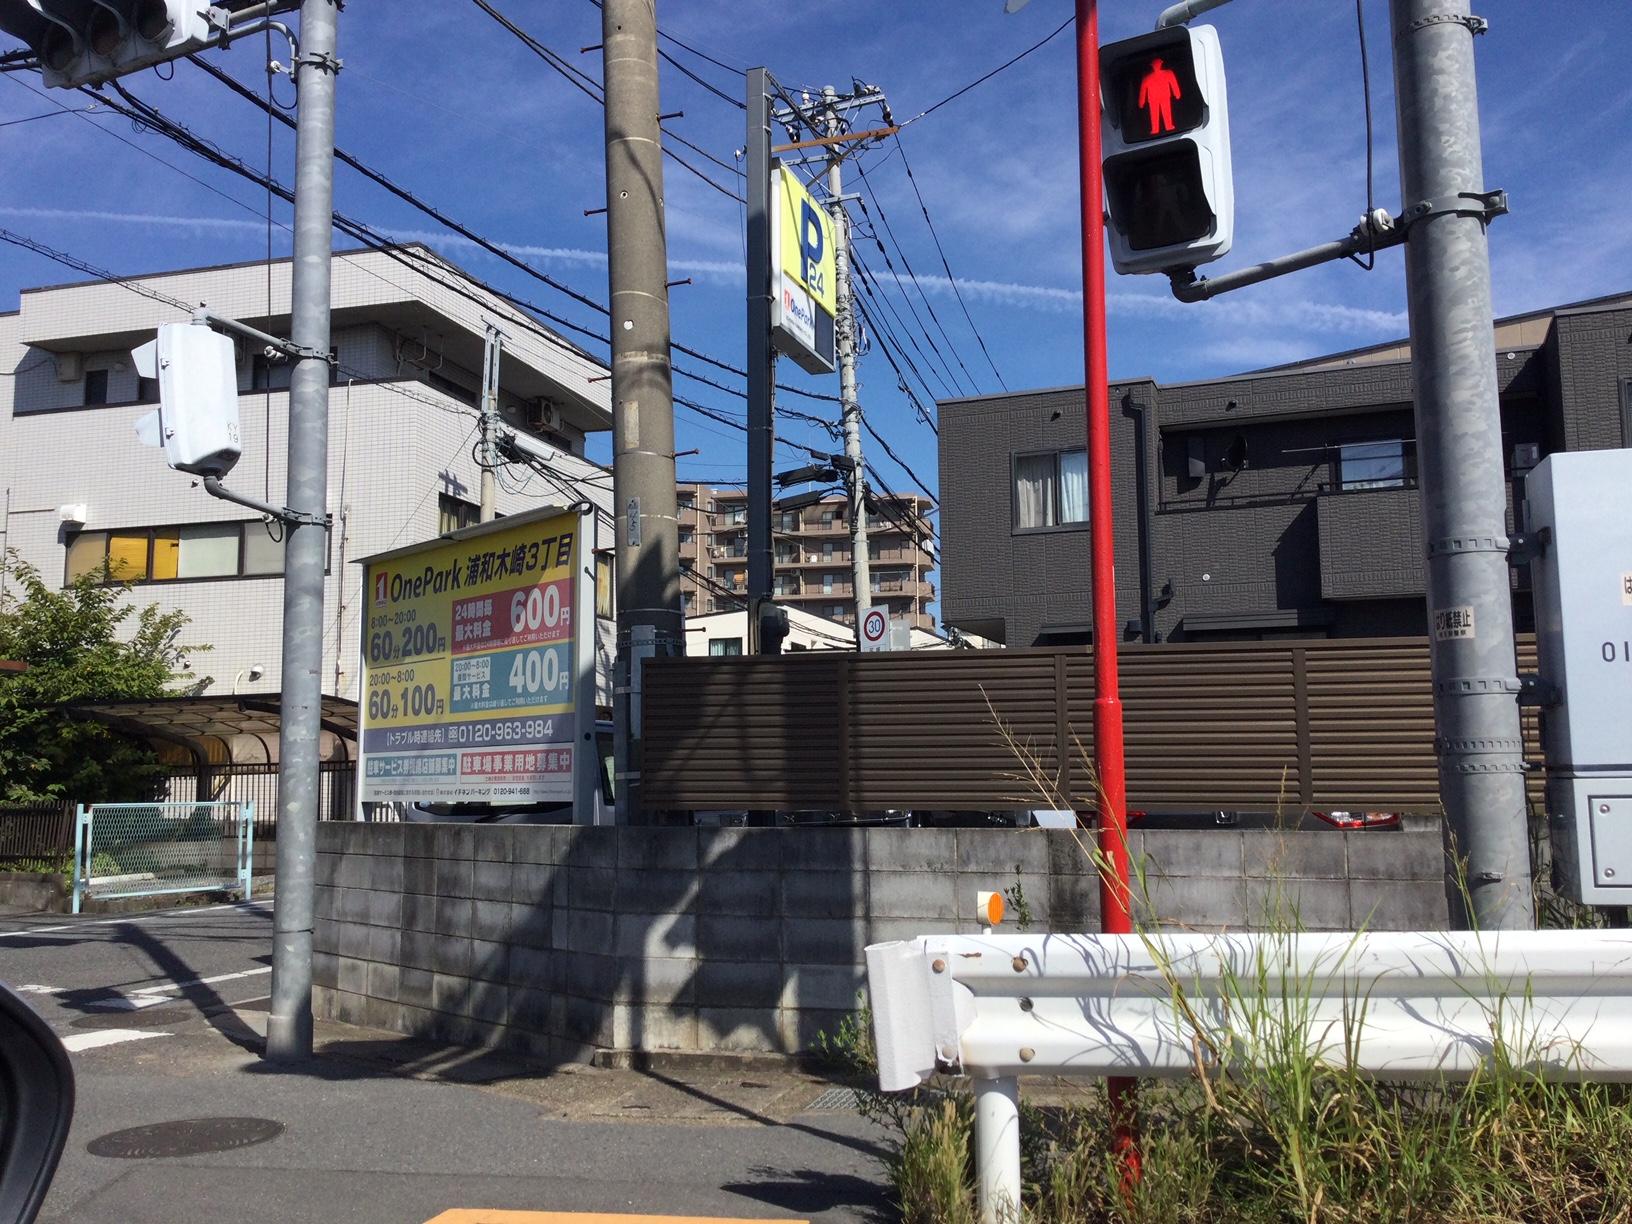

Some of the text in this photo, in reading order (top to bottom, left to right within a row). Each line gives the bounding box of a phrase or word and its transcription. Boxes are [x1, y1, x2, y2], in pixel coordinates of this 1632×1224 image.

[801, 197, 824, 283] P
[809, 262, 825, 298] 24
[391, 559, 462, 602] OnePark
[464, 533, 573, 587] 浦和木崎3丁目
[510, 585, 570, 633] 600円
[868, 619, 880, 633] 30
[455, 619, 492, 641] 最大料金
[509, 648, 569, 693] 400円
[453, 682, 490, 701] 最大料金
[458, 719, 553, 742] 0120-963-984
